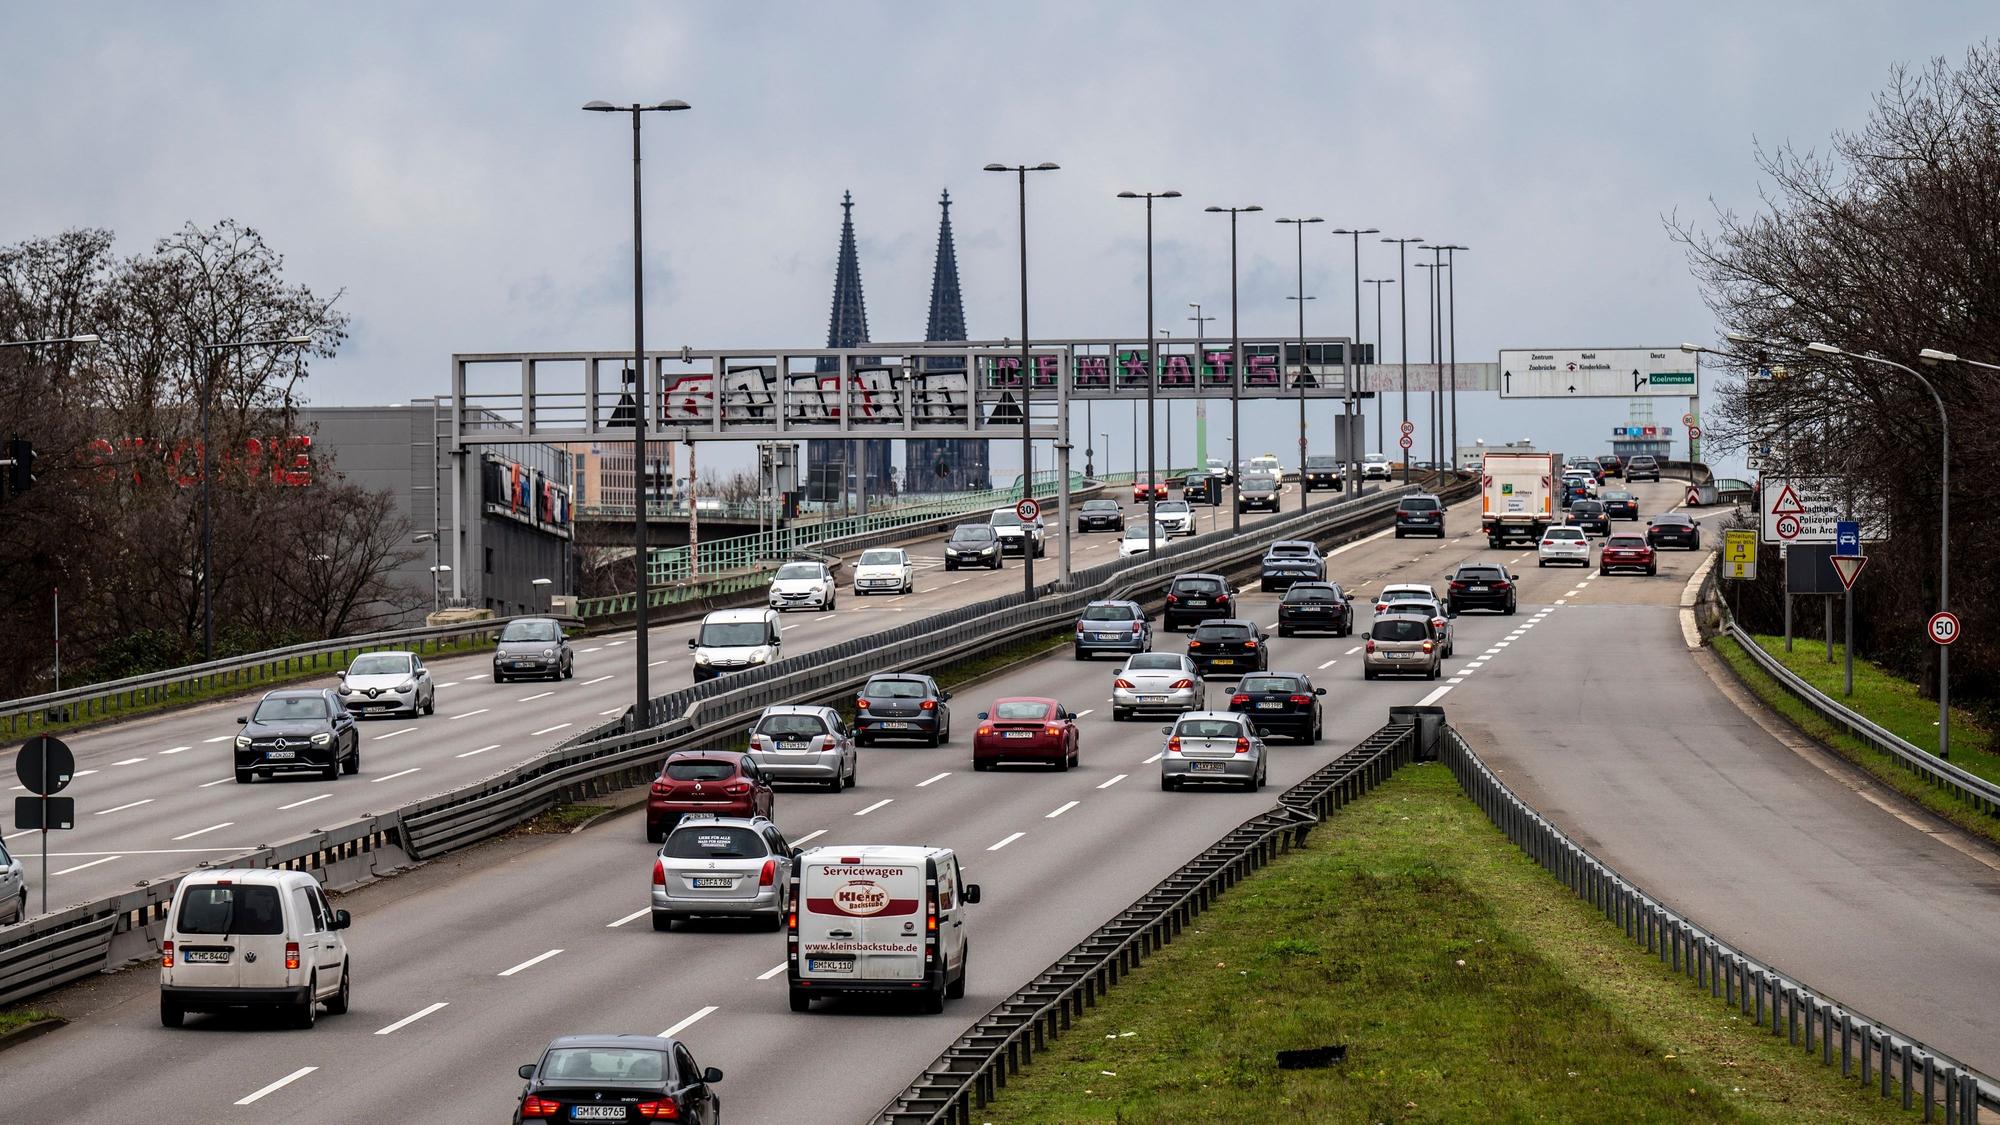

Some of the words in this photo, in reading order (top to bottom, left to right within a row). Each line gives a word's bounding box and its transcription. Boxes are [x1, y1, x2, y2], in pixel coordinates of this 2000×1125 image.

[1652, 375, 1692, 383] Koelnmesse
[1020, 505, 1035, 515] 30t
[1800, 526, 1817, 535] Köln
[1936, 621, 1953, 635] 50
[823, 866, 903, 878] Servicewagen
[839, 891, 884, 902] Kleins
[849, 902, 884, 910] Backstube
[805, 942, 918, 952] www.kleinsbackstube.de
[838, 962, 852, 970] 110
[577, 1107, 589, 1116] GM
[602, 1107, 625, 1116] 8765
